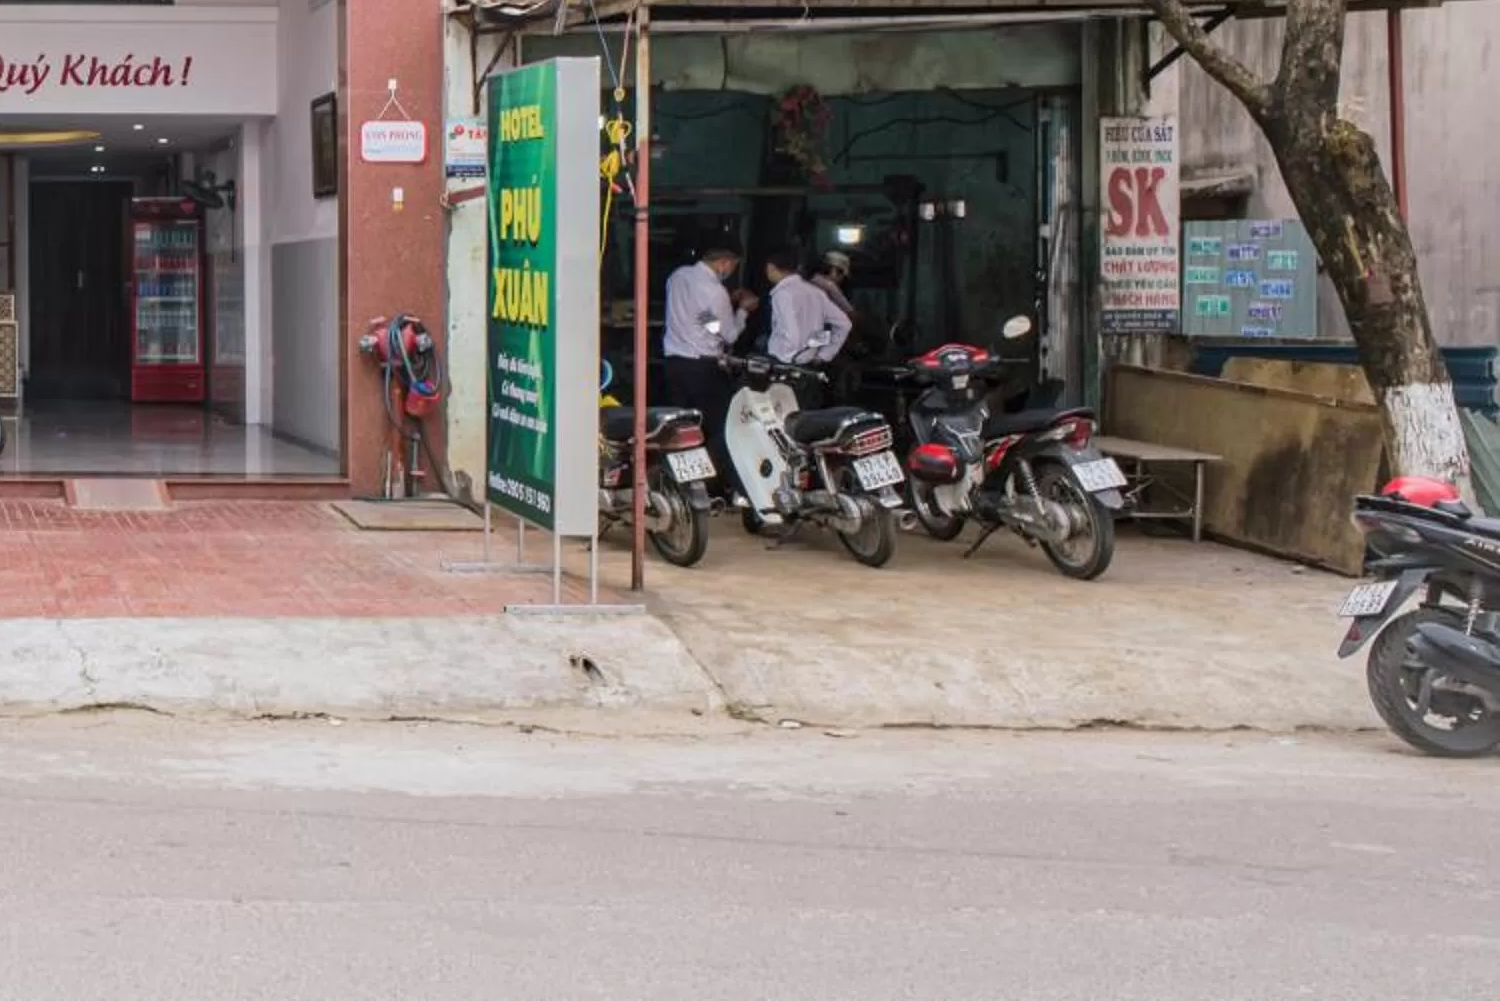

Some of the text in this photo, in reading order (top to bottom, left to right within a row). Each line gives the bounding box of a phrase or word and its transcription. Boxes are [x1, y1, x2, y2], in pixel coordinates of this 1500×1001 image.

[500, 104, 545, 142] HOTEL
[501, 176, 542, 243] PHÚ
[1104, 166, 1171, 238] SK
[492, 256, 549, 329] XUÂN
